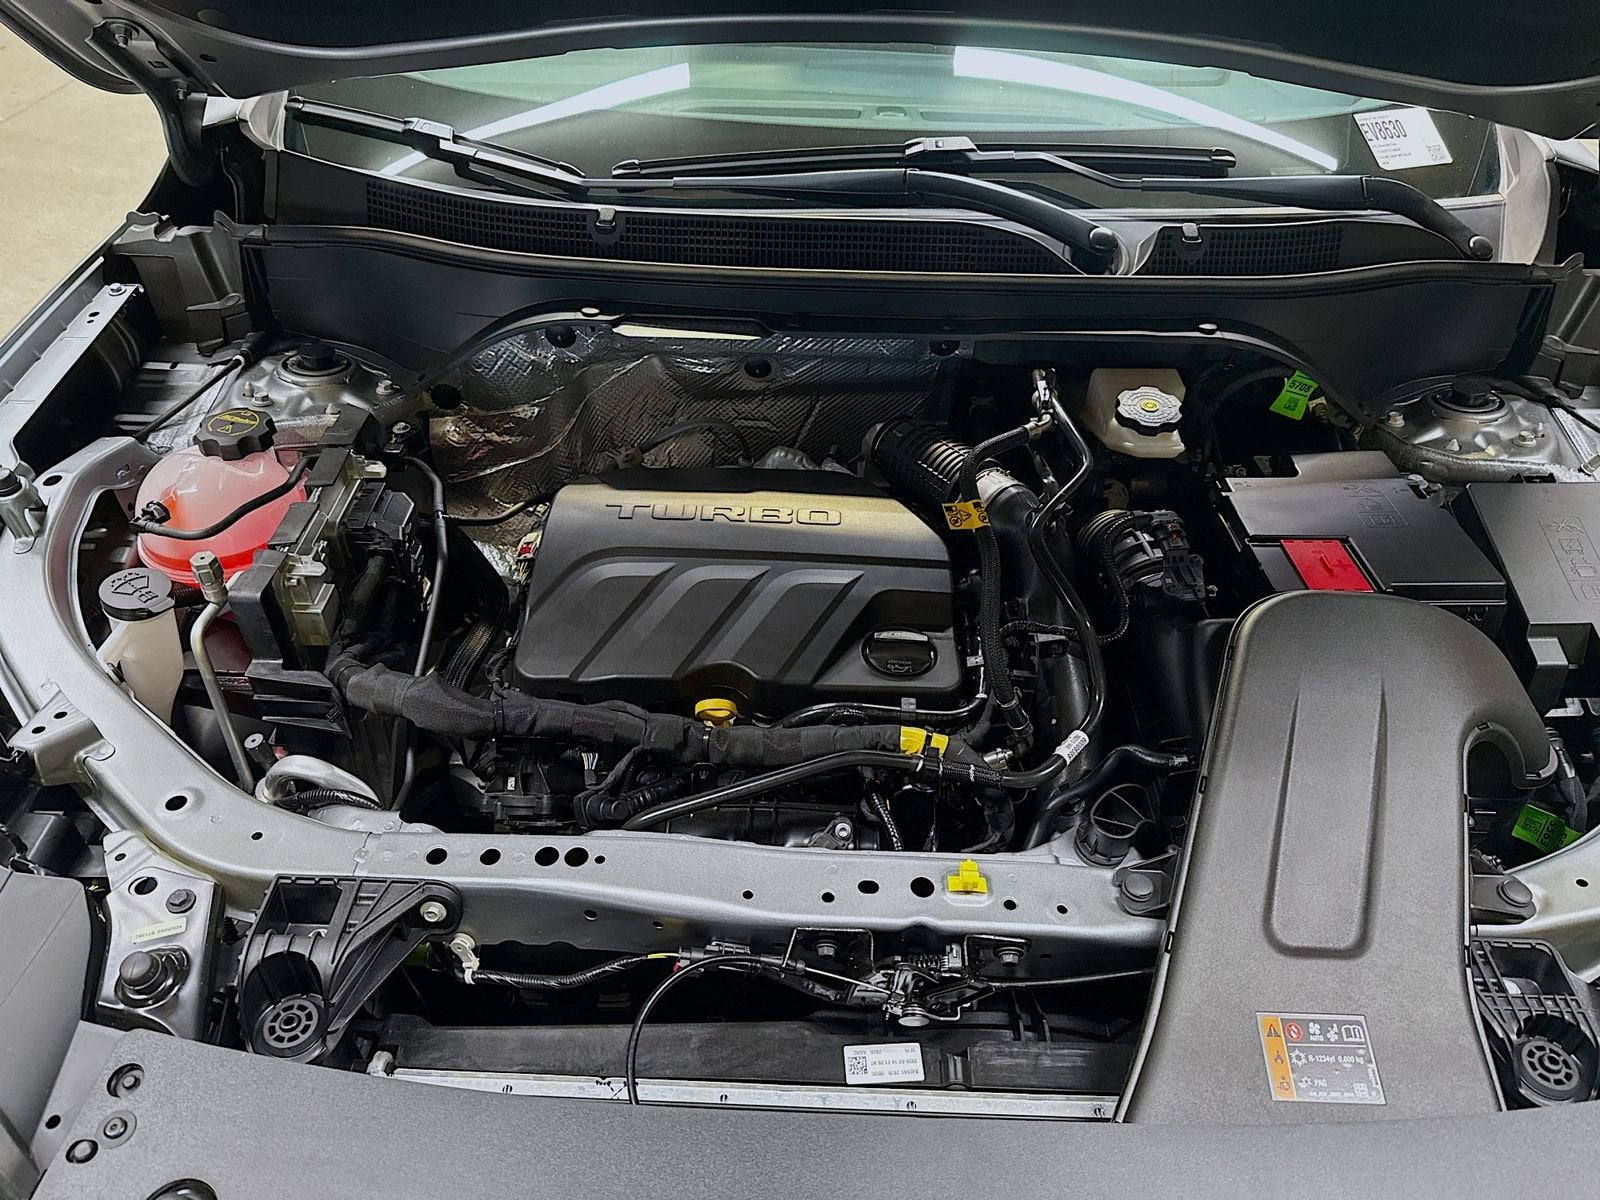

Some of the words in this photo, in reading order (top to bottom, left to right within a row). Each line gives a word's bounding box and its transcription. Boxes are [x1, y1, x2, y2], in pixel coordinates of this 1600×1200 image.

[1360, 120, 1407, 141] EV8630
[1289, 380, 1312, 392] 5708
[606, 503, 841, 526] TURBO
[1355, 1055, 1364, 1065] kg
